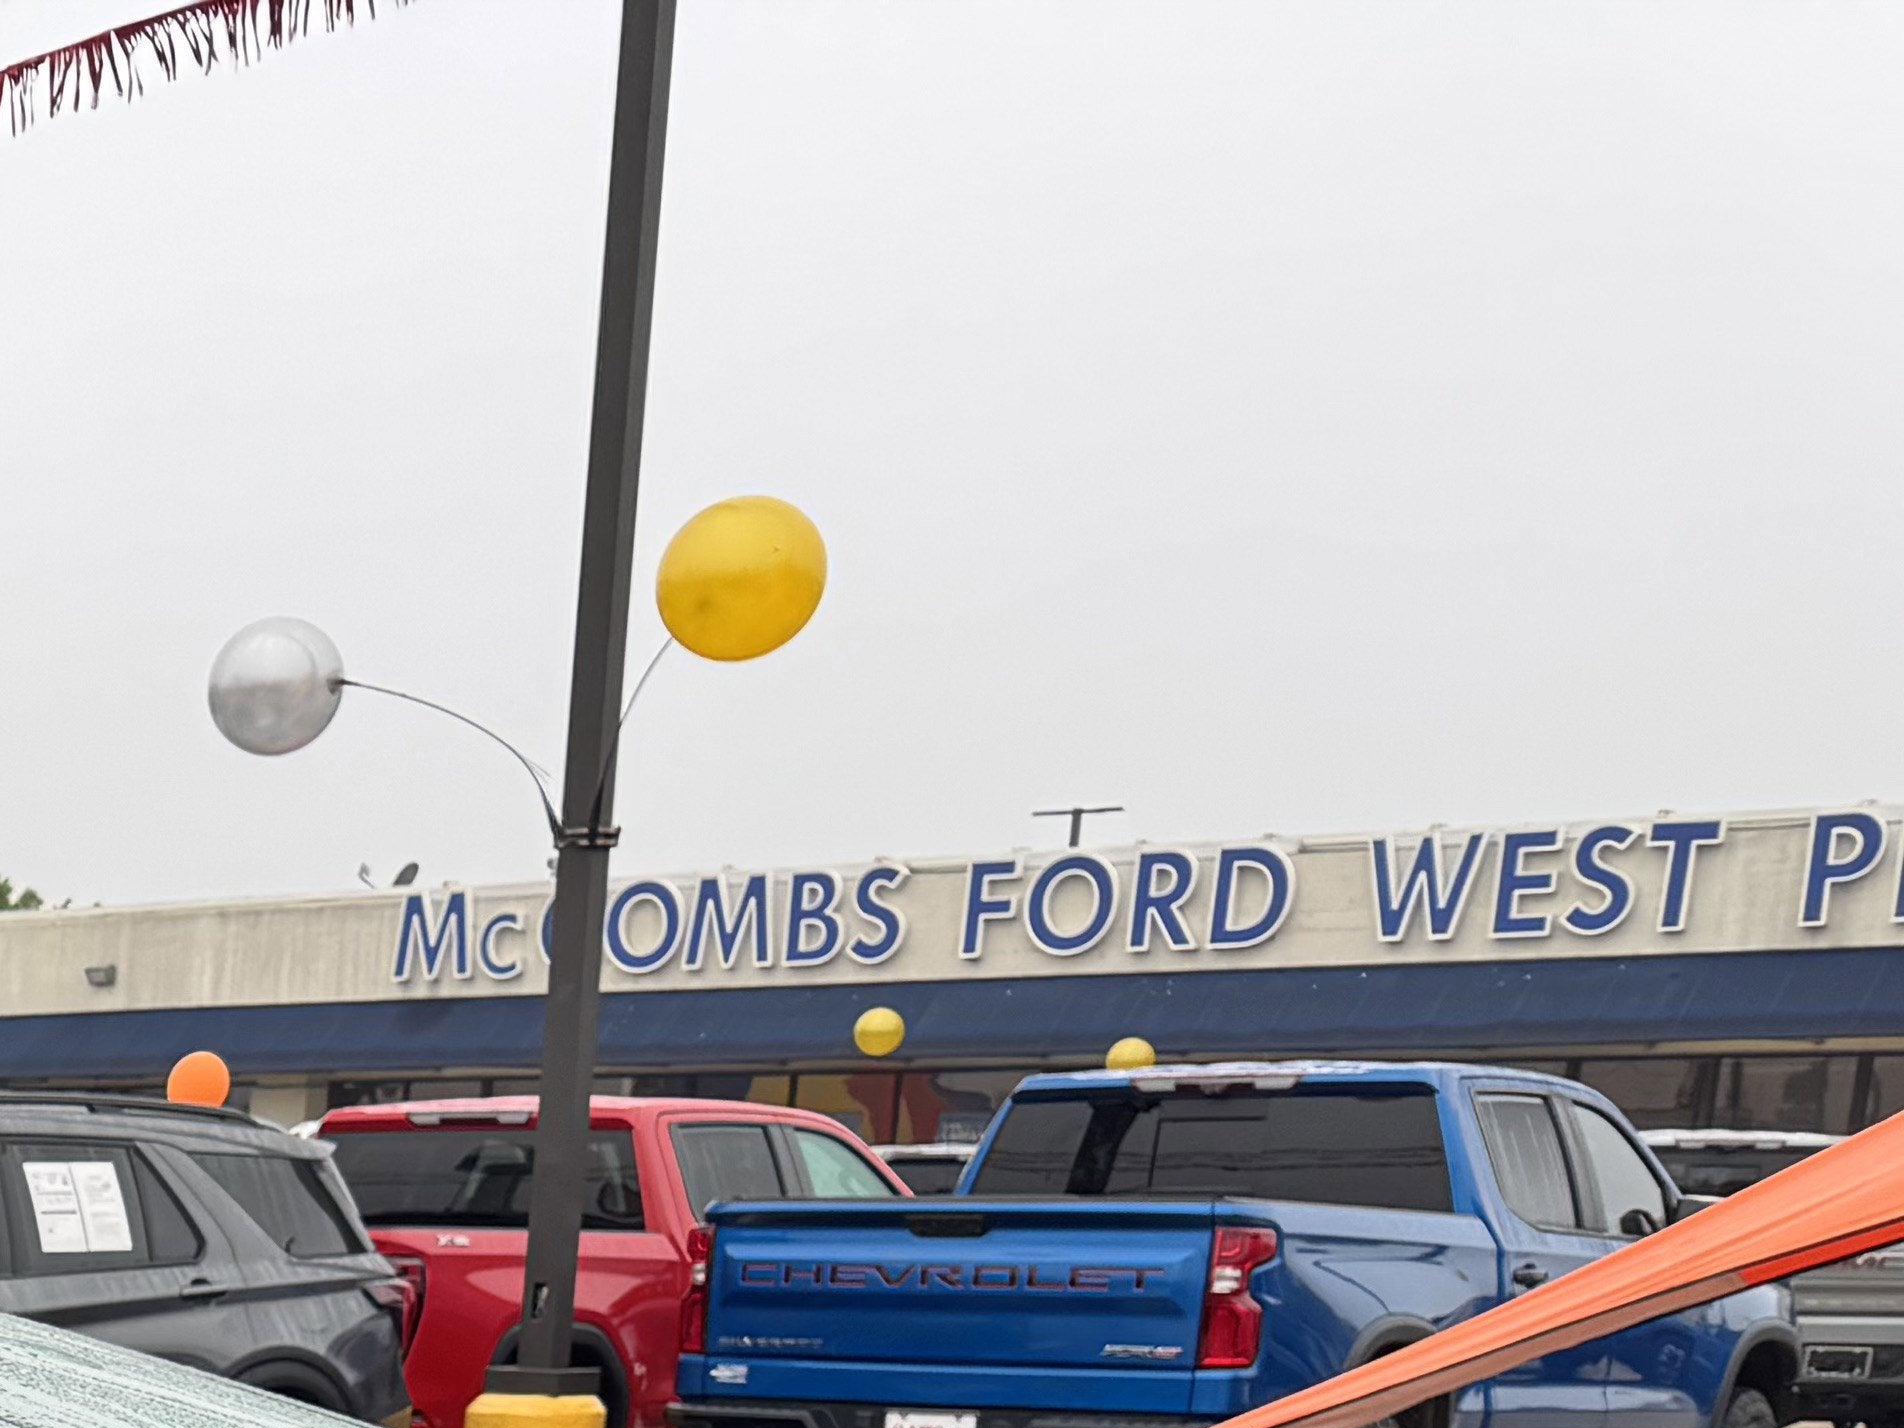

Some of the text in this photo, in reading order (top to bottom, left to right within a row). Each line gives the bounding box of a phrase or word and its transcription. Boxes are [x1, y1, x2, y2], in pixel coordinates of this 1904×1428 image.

[393, 812, 1904, 981] McOMBS FORD WEST P
[741, 1263, 1165, 1292] CHEVROLET
